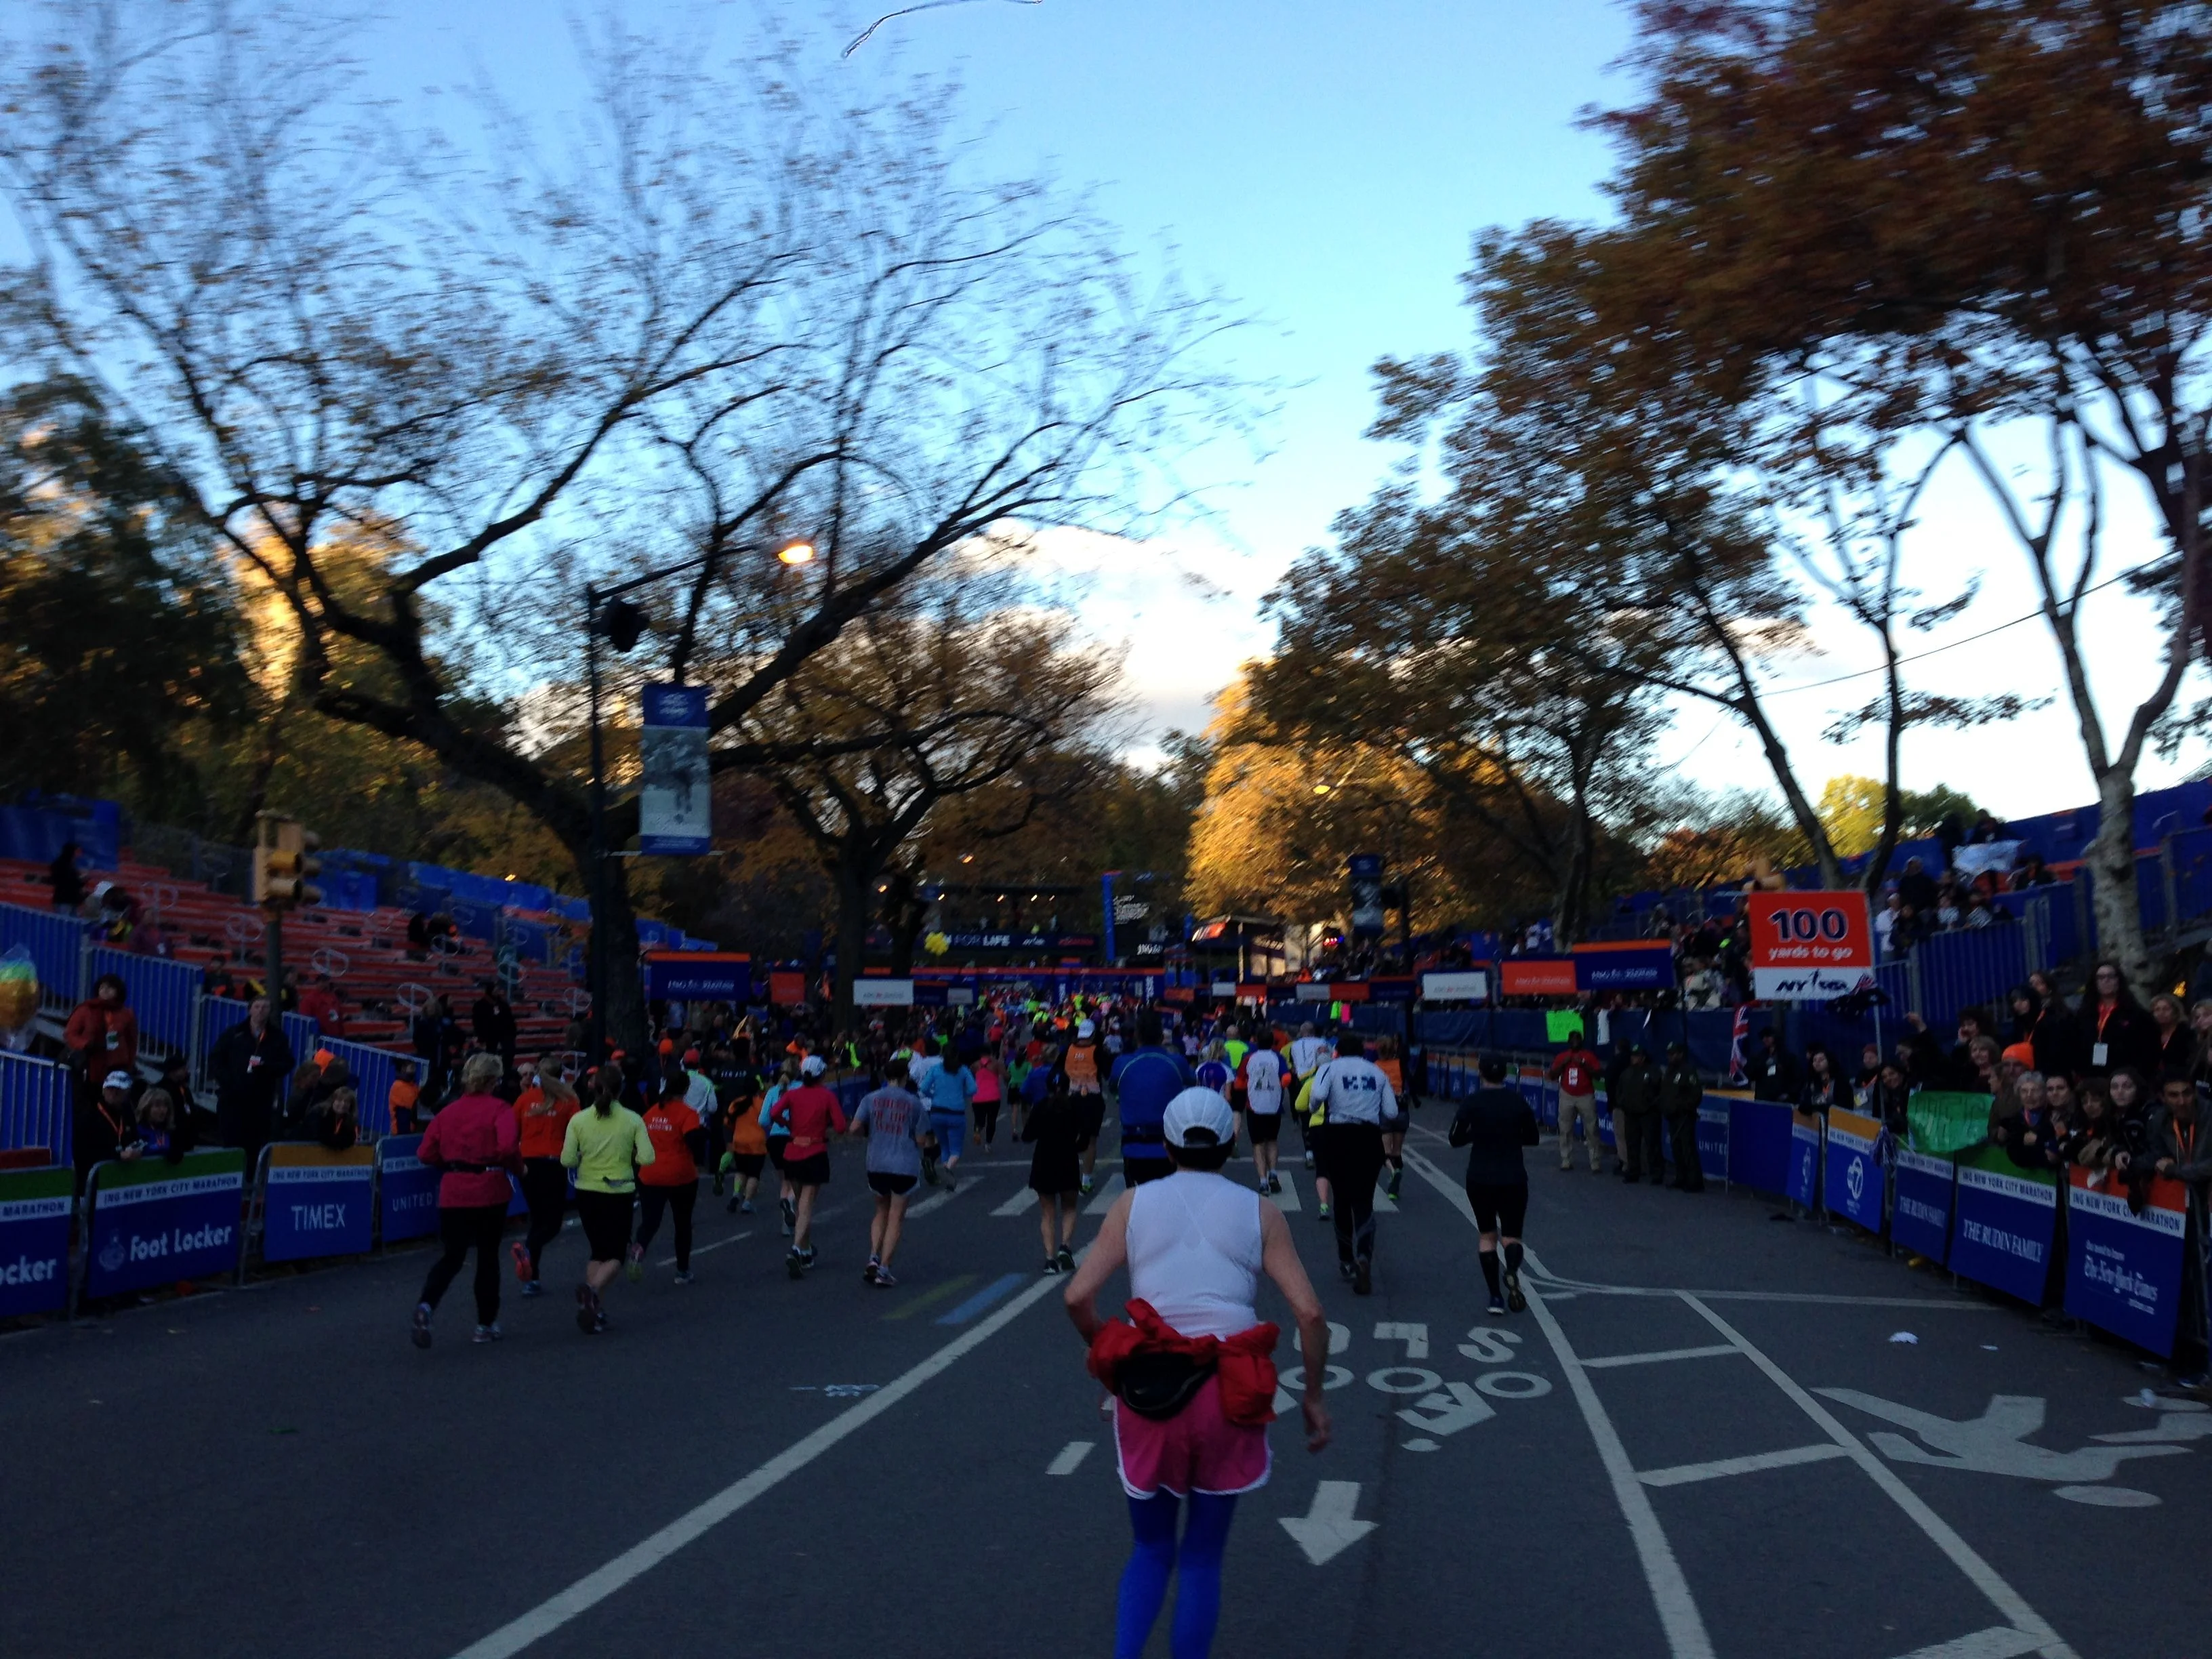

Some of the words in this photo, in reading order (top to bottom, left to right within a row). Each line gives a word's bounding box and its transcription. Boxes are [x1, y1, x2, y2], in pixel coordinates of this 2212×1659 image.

[1767, 907, 1849, 943] 100
[982, 935, 1011, 947] LIFE
[1768, 945, 1809, 962] yards
[1811, 945, 1830, 958] to
[1831, 947, 1853, 961] go
[104, 1192, 120, 1204] ING
[123, 1190, 142, 1200] NEW
[146, 1185, 167, 1196] YORK
[171, 1183, 189, 1193] CITY
[193, 1176, 237, 1189] MARATHON
[1974, 1173, 1986, 1185] NEW
[1988, 1176, 2003, 1188] YORK
[2005, 1180, 2018, 1192] CITY
[2020, 1183, 2053, 1202] MARATHON
[3, 1202, 65, 1217] MARATHON
[392, 1192, 433, 1212] UNITED
[2073, 1193, 2084, 1206] ING
[2086, 1195, 2100, 1210] NEW
[2103, 1200, 2121, 1214] YORK
[291, 1204, 346, 1231] TIMEX
[1963, 1218, 1982, 1242] THE
[130, 1231, 168, 1262] Foot
[173, 1223, 232, 1253] Locker
